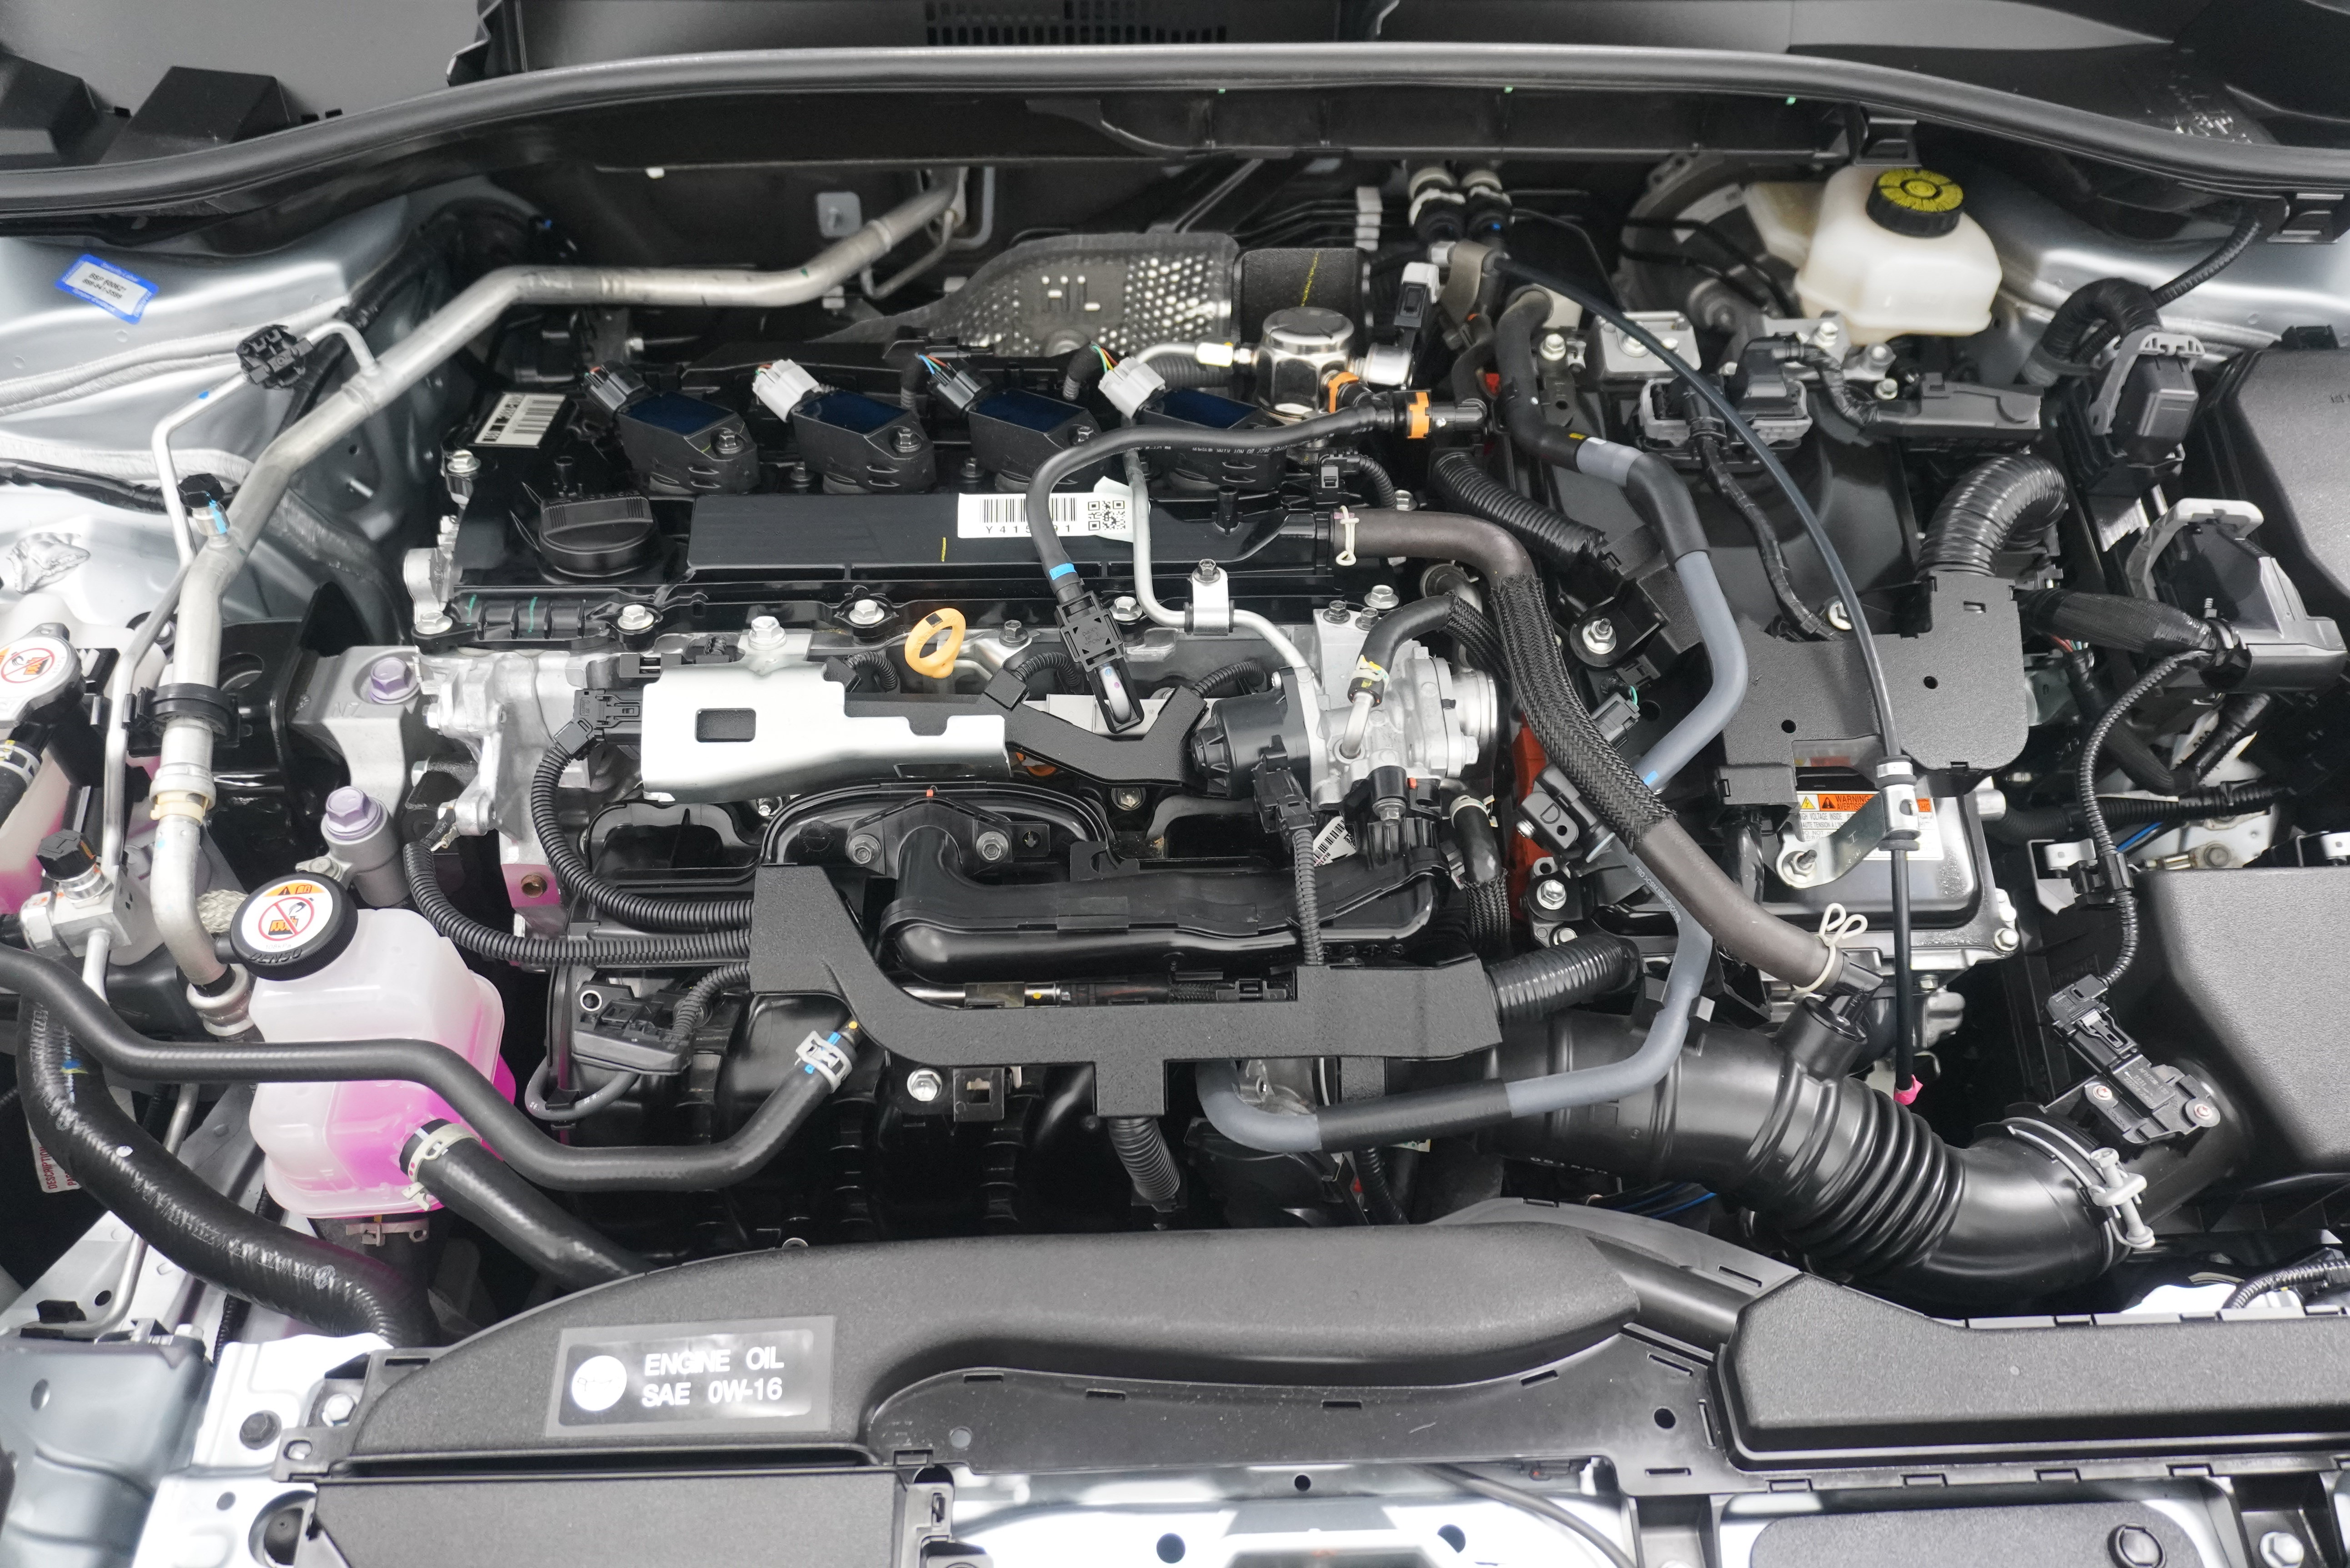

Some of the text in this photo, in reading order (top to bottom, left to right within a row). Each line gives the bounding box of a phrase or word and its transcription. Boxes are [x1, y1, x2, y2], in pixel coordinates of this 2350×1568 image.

[986, 525, 1070, 534] Y41591
[1835, 795, 1870, 804] WARNING
[247, 948, 302, 964] DENSO
[39, 1146, 58, 1190] DESCRIPTION
[644, 1346, 785, 1376] ENGINE OIL
[641, 1377, 783, 1407] SAE 0W-16
